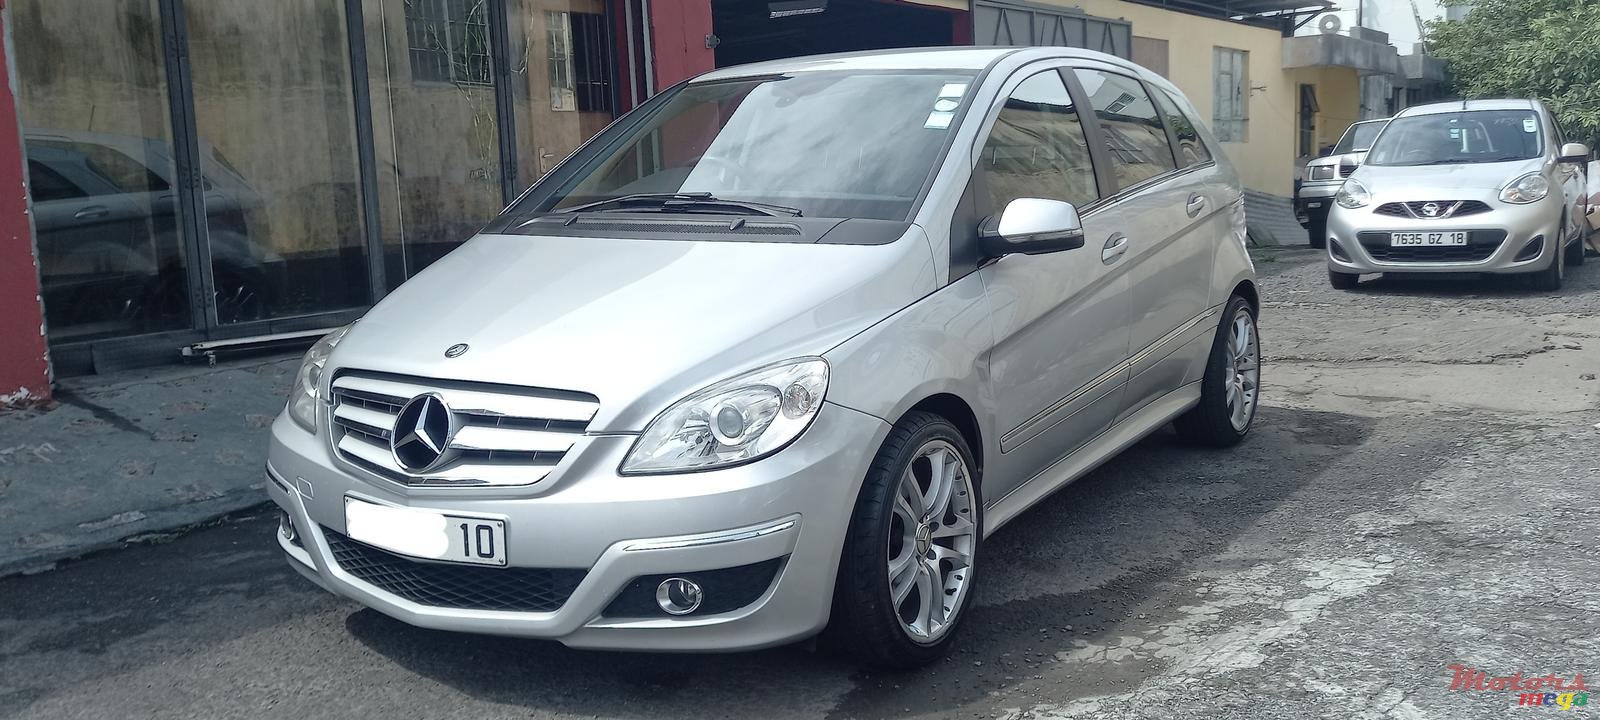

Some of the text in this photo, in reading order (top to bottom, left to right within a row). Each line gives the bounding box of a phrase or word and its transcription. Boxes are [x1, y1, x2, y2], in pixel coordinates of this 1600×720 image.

[1394, 232, 1464, 245] 7635 GZ 18
[460, 523, 495, 559] 10
